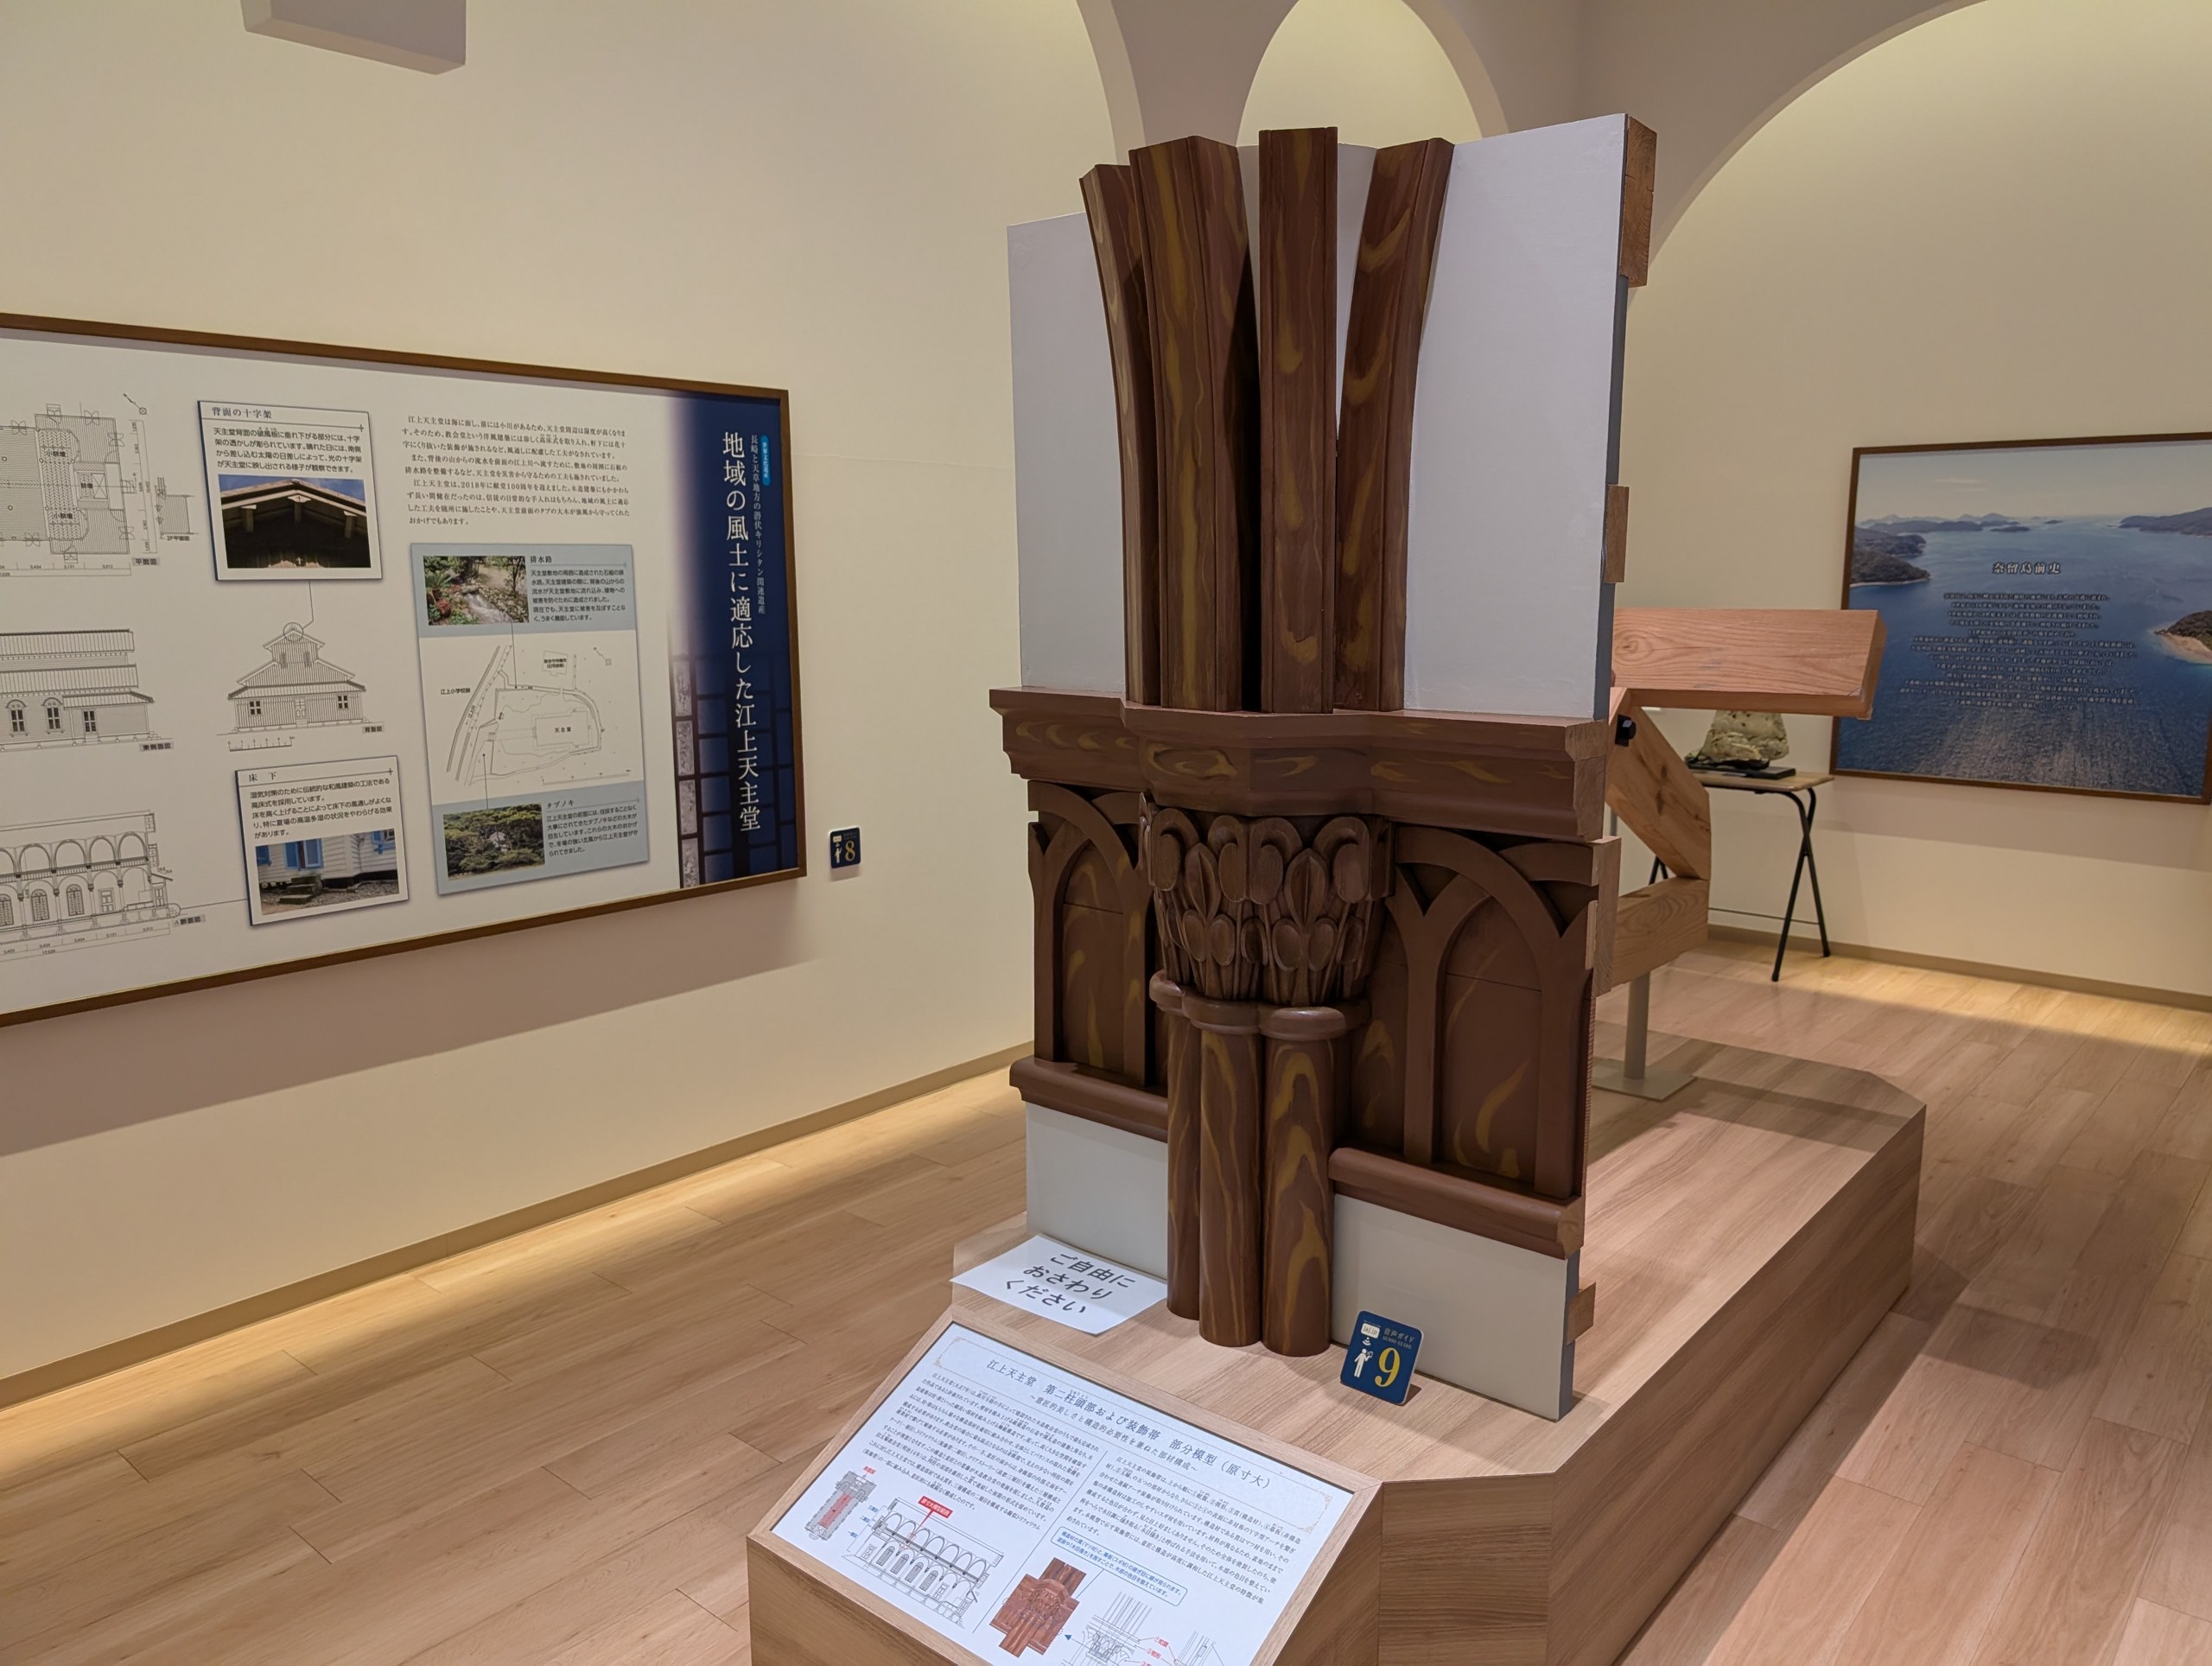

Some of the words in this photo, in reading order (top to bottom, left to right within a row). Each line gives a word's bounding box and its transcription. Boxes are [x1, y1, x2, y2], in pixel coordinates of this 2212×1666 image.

[212, 407, 272, 419] 背面の十字架
[216, 449, 362, 463] から差し込む太陽の日差しによって、光の十字架
[217, 460, 353, 474] が天主堂に映し出される様子が観察できます。
[409, 517, 468, 525] おかげでもあります。
[1993, 563, 2060, 574] 奈留島前史
[722, 431, 760, 831] 地域の風土に適応した江上天主堂
[249, 772, 276, 782] 床下
[251, 778, 391, 798] 湿気対策のために伝統的な和風建築の工法である
[251, 795, 324, 809] 高床式を採用しています。
[252, 797, 391, 819] 床を高く上げることによって床下の風通しがよくな
[547, 800, 574, 809] タブノキ
[253, 806, 392, 829] り、特に夏場の高温多湿の状況をやわらげる効果
[254, 830, 289, 839] があります。
[845, 841, 855, 862] 8
[1051, 1253, 1135, 1288] ご自由に
[1023, 1265, 1113, 1300] おさわり
[1007, 1280, 1086, 1313] ください
[1375, 1347, 1400, 1387] 9
[985, 1358, 1039, 1388] 江上天主堂
[1042, 1382, 1162, 1441] 第二柱頭部および装飾帯
[1167, 1437, 1274, 1491] 部分模型（原寸大）
